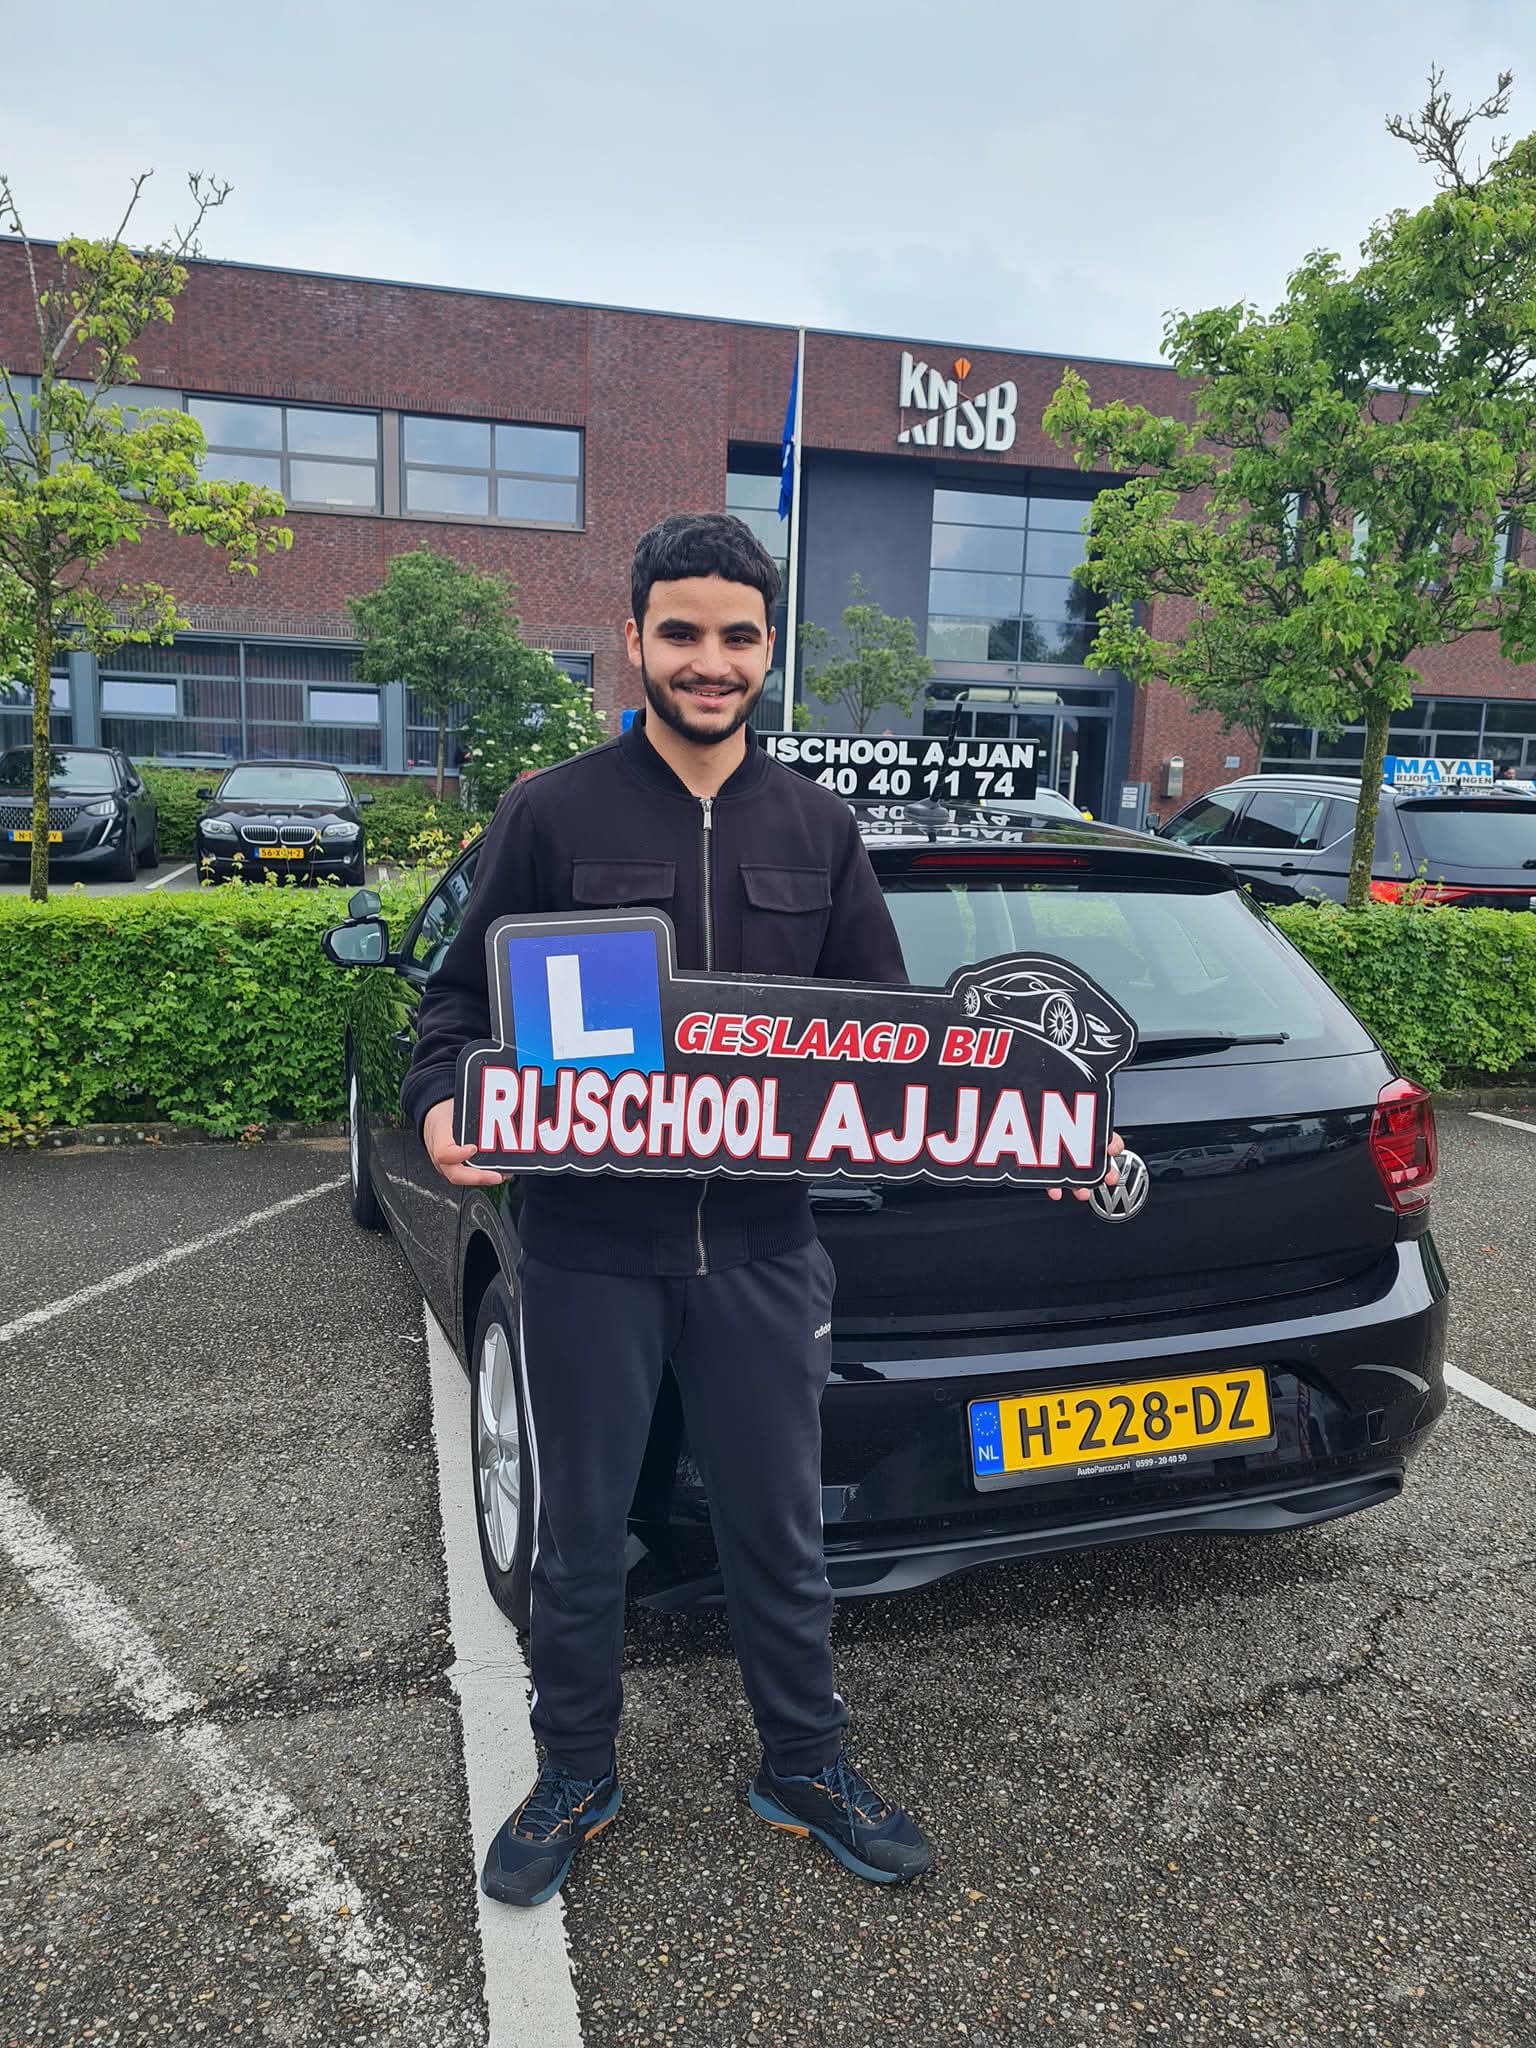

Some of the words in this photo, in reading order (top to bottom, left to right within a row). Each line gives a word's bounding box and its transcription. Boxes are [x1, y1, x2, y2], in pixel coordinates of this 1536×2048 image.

[898, 351, 1018, 451] KNSB
[922, 742, 1034, 768] AJJAN
[1396, 759, 1492, 776] MAYAR
[815, 767, 857, 795] 40
[868, 769, 911, 796] 40
[923, 769, 960, 797] 11
[975, 771, 1015, 797] 74
[1396, 774, 1492, 785] RIJOPLEIDNGEN
[546, 954, 635, 1061] L
[674, 1011, 929, 1064] GESLAAGD
[938, 1025, 1014, 1069] BIJ
[478, 1065, 792, 1160] RIJSCHOOL
[807, 1080, 1098, 1169] AJJAN
[978, 1446, 999, 1461] NL
[1077, 1460, 1131, 1476] AutoParcours.nl
[1158, 1456, 1167, 1465] 20
[1178, 1453, 1188, 1462] 50
